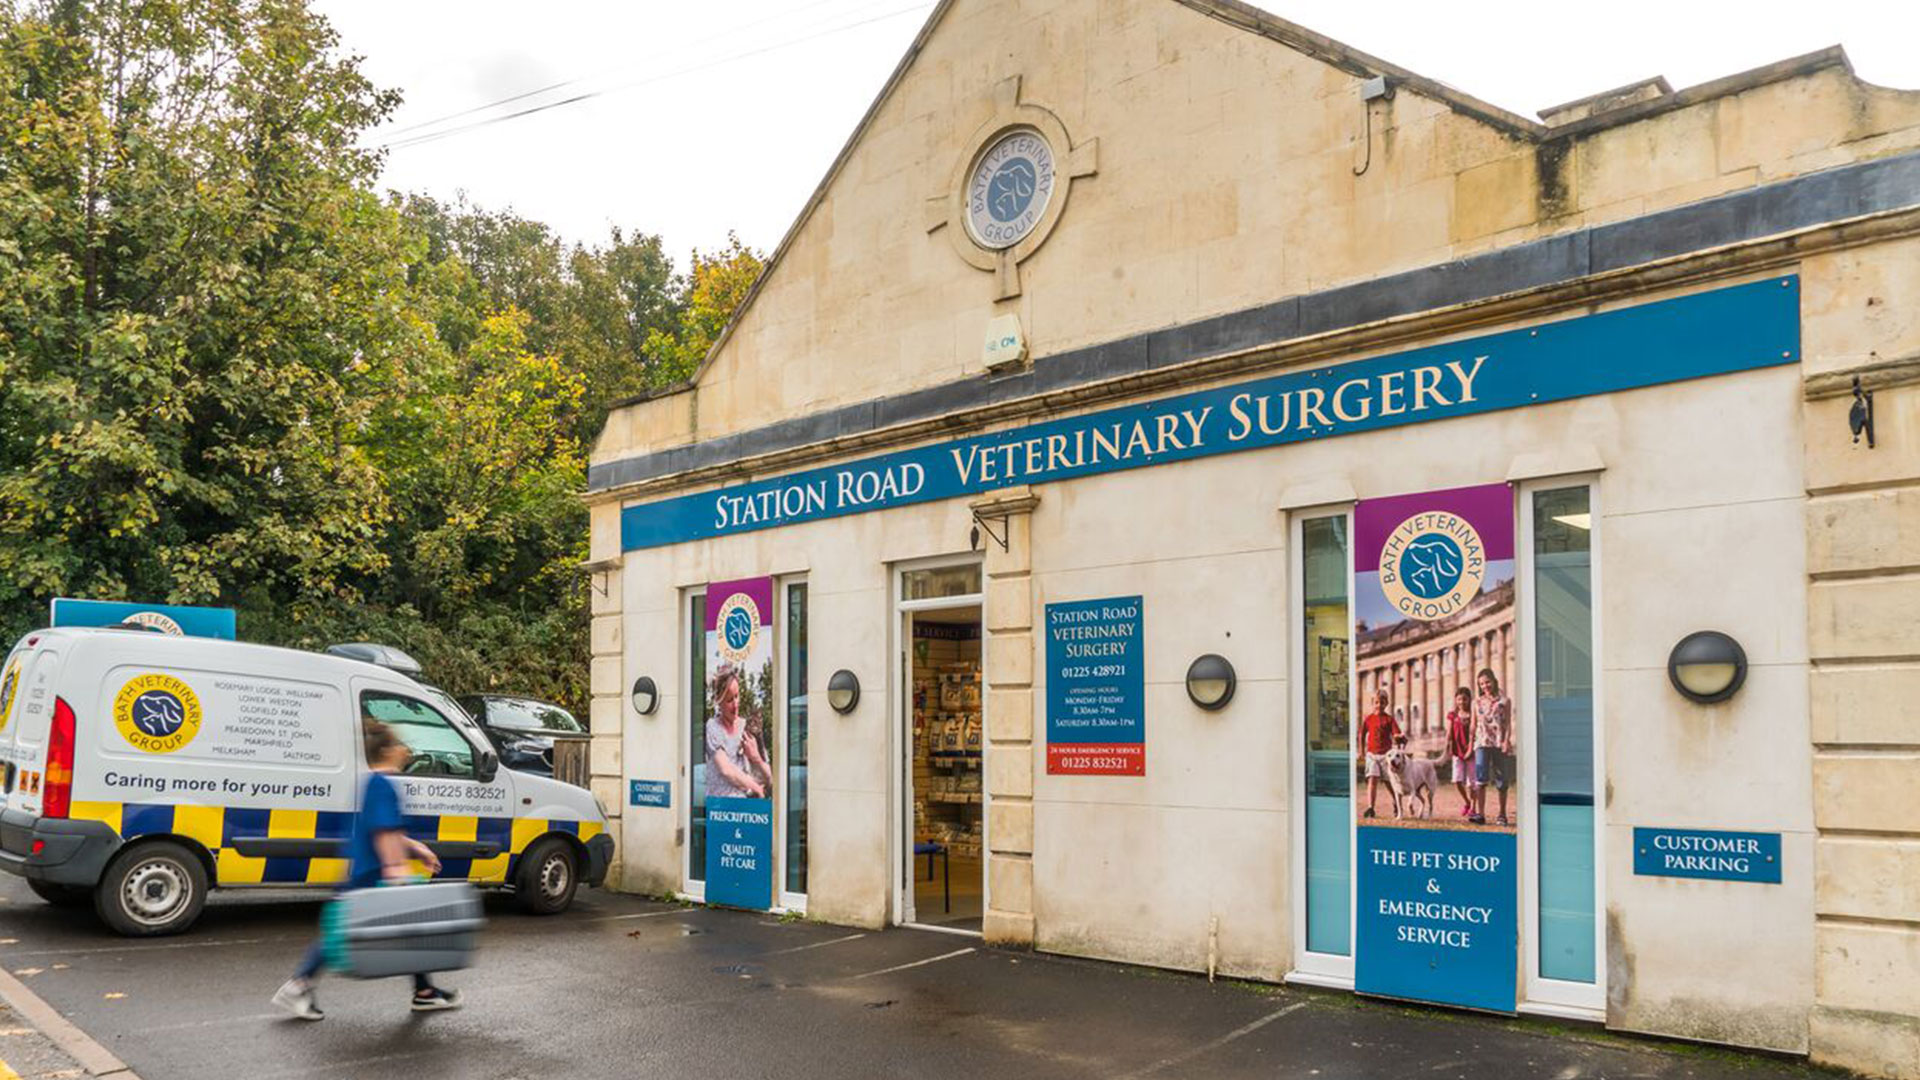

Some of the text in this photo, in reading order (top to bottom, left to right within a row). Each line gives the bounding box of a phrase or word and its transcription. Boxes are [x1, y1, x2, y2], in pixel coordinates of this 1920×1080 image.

[974, 138, 1052, 214] BATH VETERINARY
[984, 211, 1034, 241] GROUP
[715, 355, 1489, 529] STATION ROAD VETERINARY SURGERY
[1383, 514, 1482, 583] BATH VETERINARY
[1399, 592, 1461, 618] GROUP
[718, 595, 760, 639] BATH VETERINARY
[1051, 606, 1137, 624] STATION ROAD
[1053, 622, 1135, 641] VETERINARY
[725, 645, 750, 661] GROUP
[1066, 642, 1127, 658] SURGERY
[1061, 665, 1125, 678] 01225 428921
[214, 681, 254, 692] ROSEMARY
[117, 675, 200, 727] BATH VETERINARY
[239, 695, 303, 708] LOWER WESTON
[240, 705, 299, 718] OLDFIELD PARK
[239, 716, 301, 728] LONDON ROAD
[1056, 718, 1090, 727] SATURDAY
[225, 725, 276, 736] PEASEDOWN
[291, 731, 312, 740] JOHN
[129, 732, 183, 751] GROUP
[244, 738, 293, 748] MARSHFIELD
[212, 746, 321, 761] MELKSHAM SALTFORD
[1050, 746, 1057, 754] 24
[1116, 747, 1140, 755] SERVICE
[1061, 757, 1127, 769] 01225 832521
[104, 771, 332, 798] Caring more for your pets!
[405, 783, 505, 800] Tel: 01225 832521
[635, 783, 665, 793] CUSTOMER
[638, 793, 662, 804] PARKING
[406, 802, 503, 813] www.bathvetgroup.co.uk
[710, 810, 769, 824] PRESCRIPTIONS
[735, 828, 742, 839] &
[721, 843, 756, 856] QUALITY
[1654, 835, 1761, 854] CUSTOMER
[721, 857, 756, 870] PET CARE
[1370, 849, 1500, 872] THE PET SHOP
[1664, 854, 1749, 873] PARKING
[1426, 878, 1441, 894] &
[1379, 899, 1492, 924] EMERGENCY
[1397, 925, 1470, 948] SERVICE
